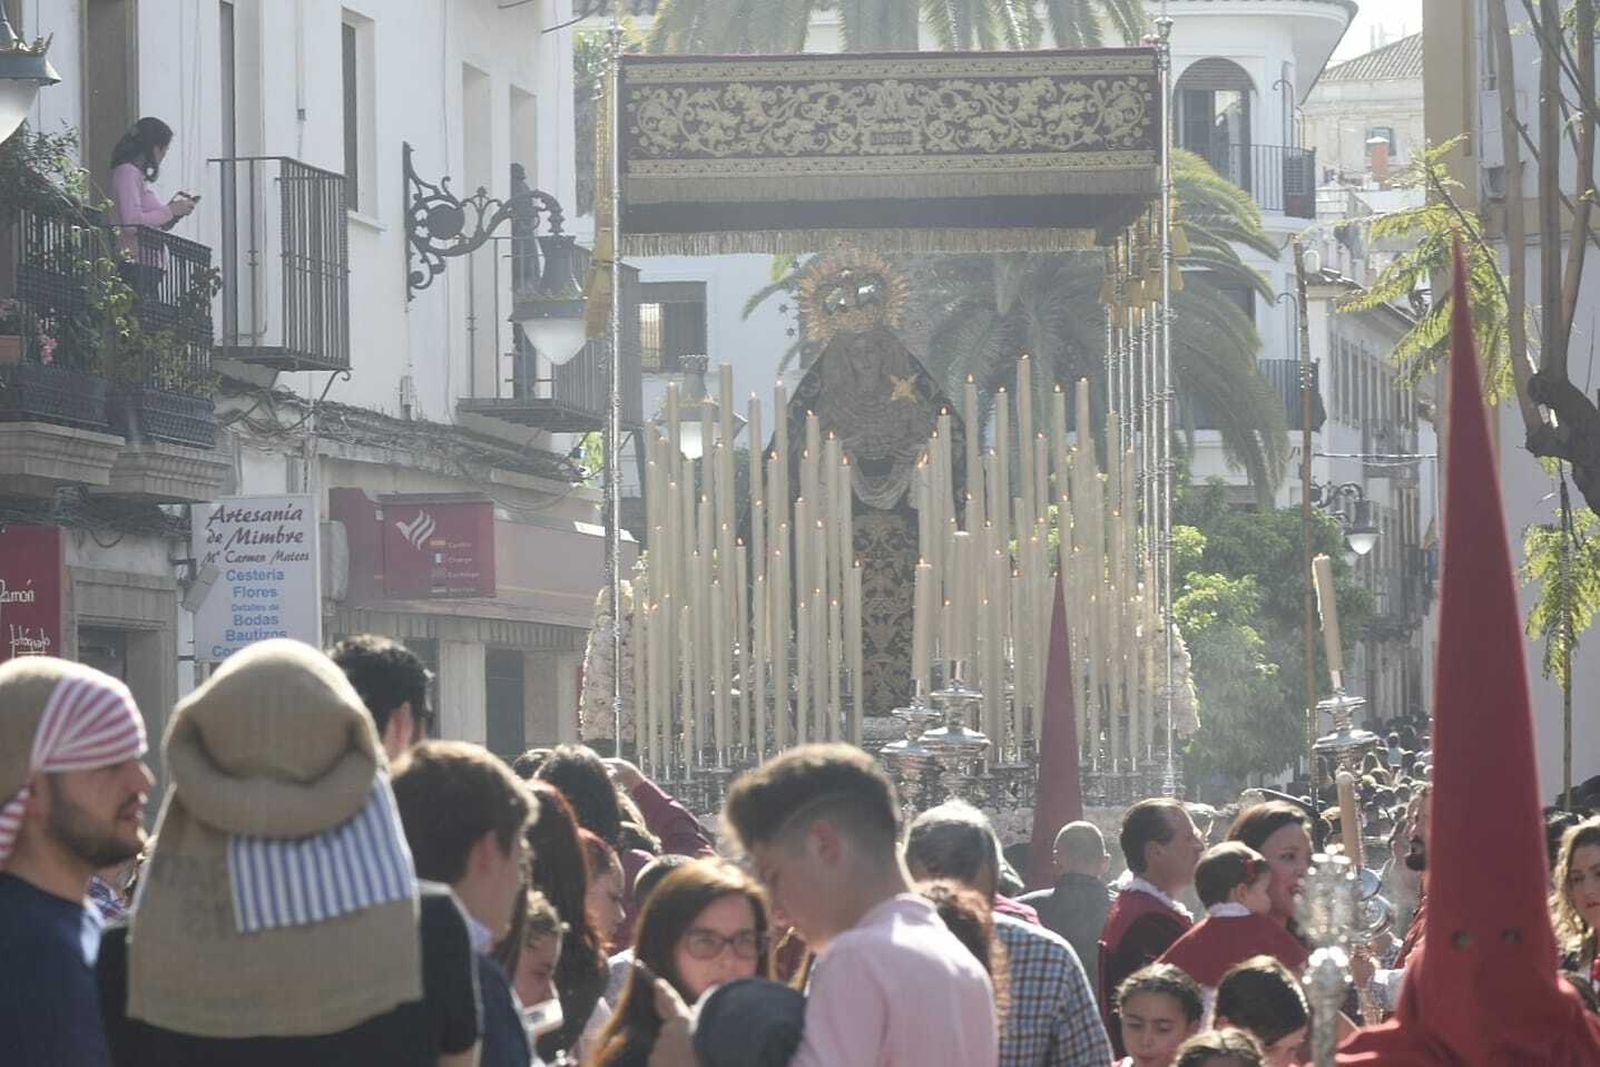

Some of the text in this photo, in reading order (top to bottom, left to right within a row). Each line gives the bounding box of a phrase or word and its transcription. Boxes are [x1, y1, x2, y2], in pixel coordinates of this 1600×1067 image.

[205, 503, 303, 529] Artesanía
[206, 525, 303, 550] de Mimbre
[225, 550, 266, 563] Carmen
[270, 550, 309, 564] Mateos
[233, 586, 279, 598] Flores
[268, 603, 279, 611] de
[233, 614, 279, 626] Bodas
[225, 629, 287, 641] Bautizos
